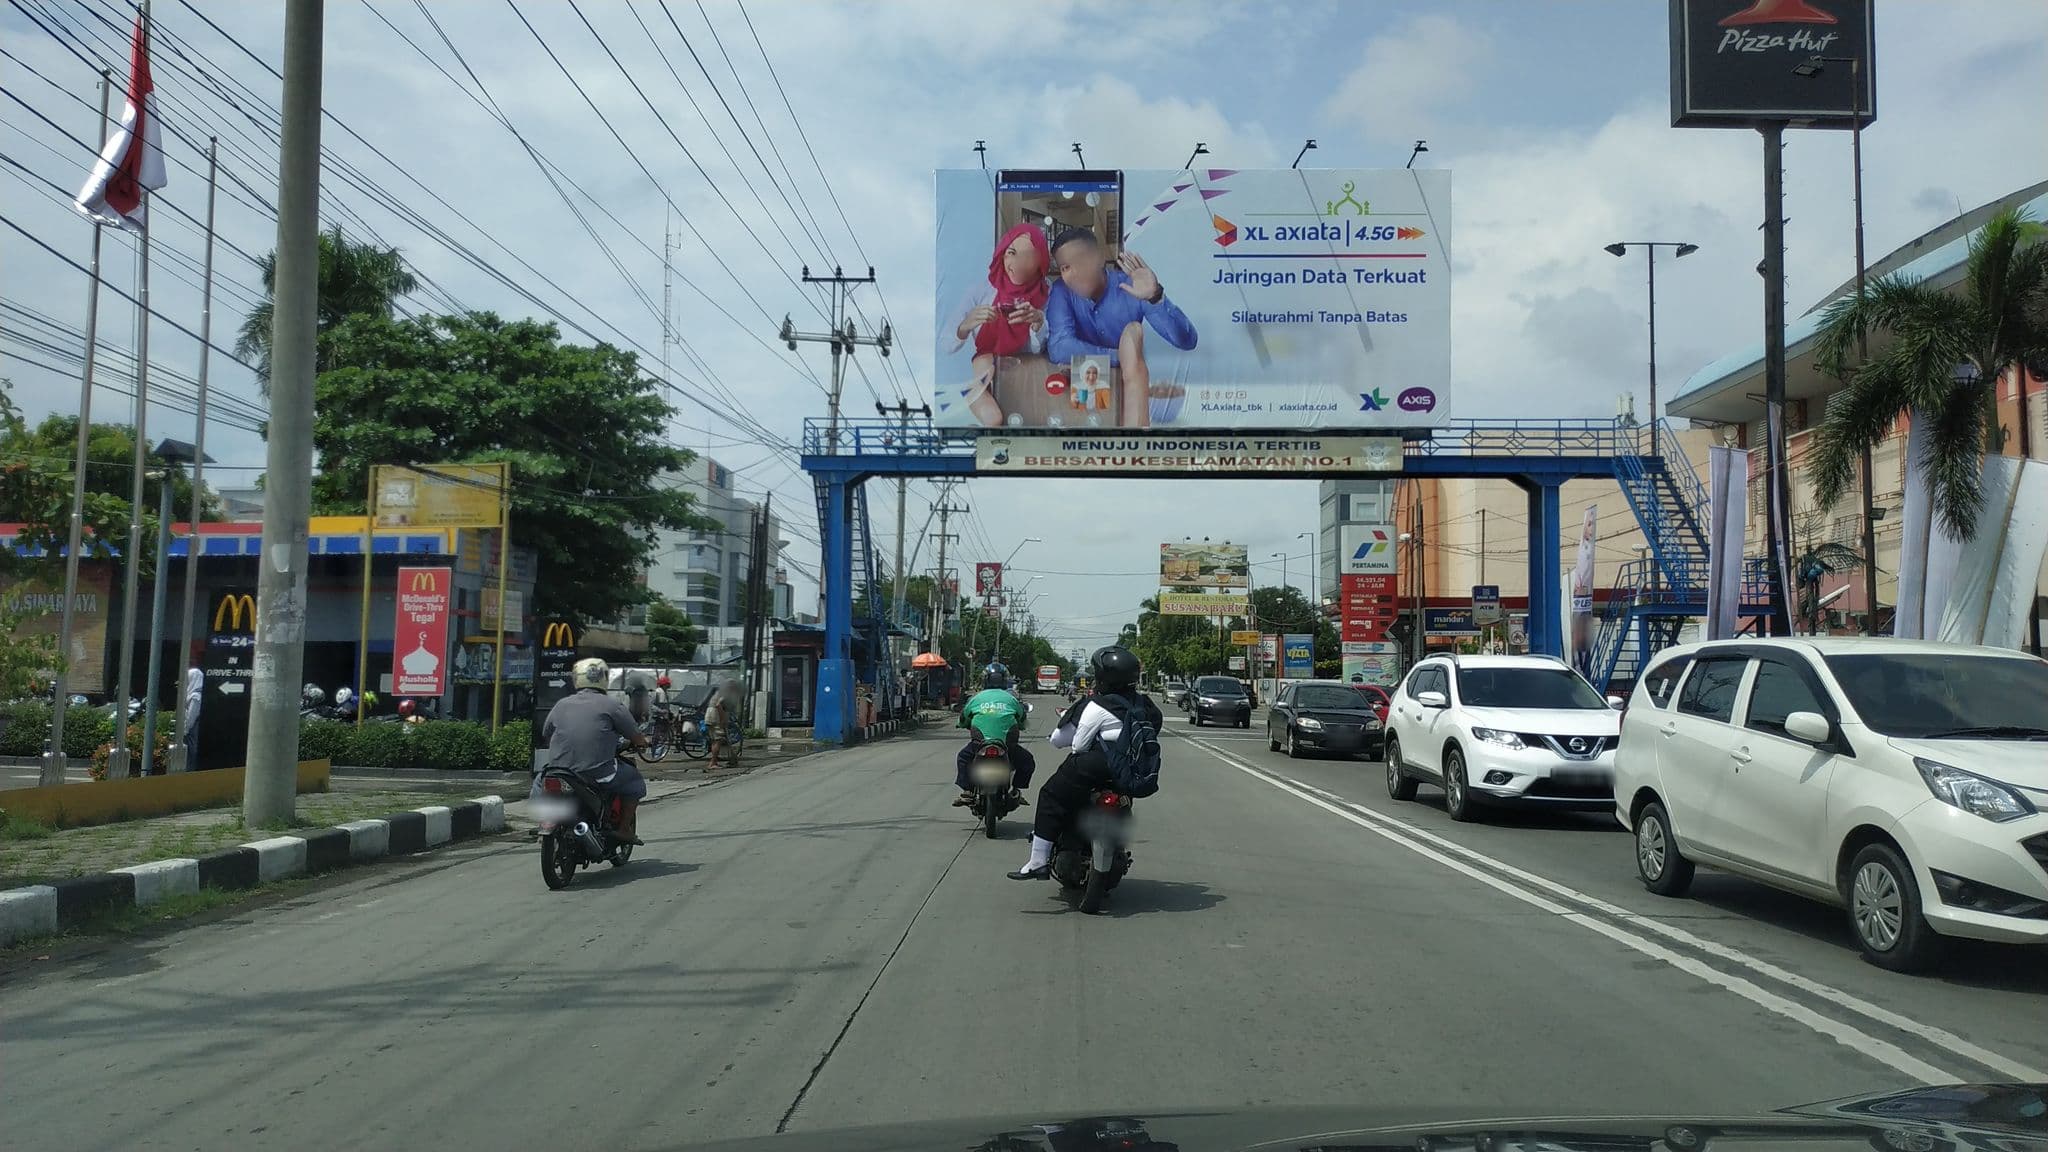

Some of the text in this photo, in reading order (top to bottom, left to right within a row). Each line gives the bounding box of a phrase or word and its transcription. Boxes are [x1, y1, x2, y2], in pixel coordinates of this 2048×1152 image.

[1717, 29, 1838, 54] Pizza Hut
[1244, 222, 1395, 241] XL axiata 4.5G
[1213, 268, 1427, 287] Jaringan Data Terkuat
[1231, 310, 1408, 325] Silaturahmi Tanpa Batas
[1401, 394, 1432, 405] AXIS
[1062, 440, 1322, 450] MENUJU INDONESIA TERTIB
[1024, 456, 1353, 466] BERSATU KESELAMATAN NO.1
[402, 594, 445, 603] McDonald's
[404, 603, 444, 612] Drive-Thru
[1164, 603, 1209, 612] SUSANA
[411, 612, 435, 624] Tegal
[231, 637, 247, 647] 24
[228, 656, 238, 664] IN
